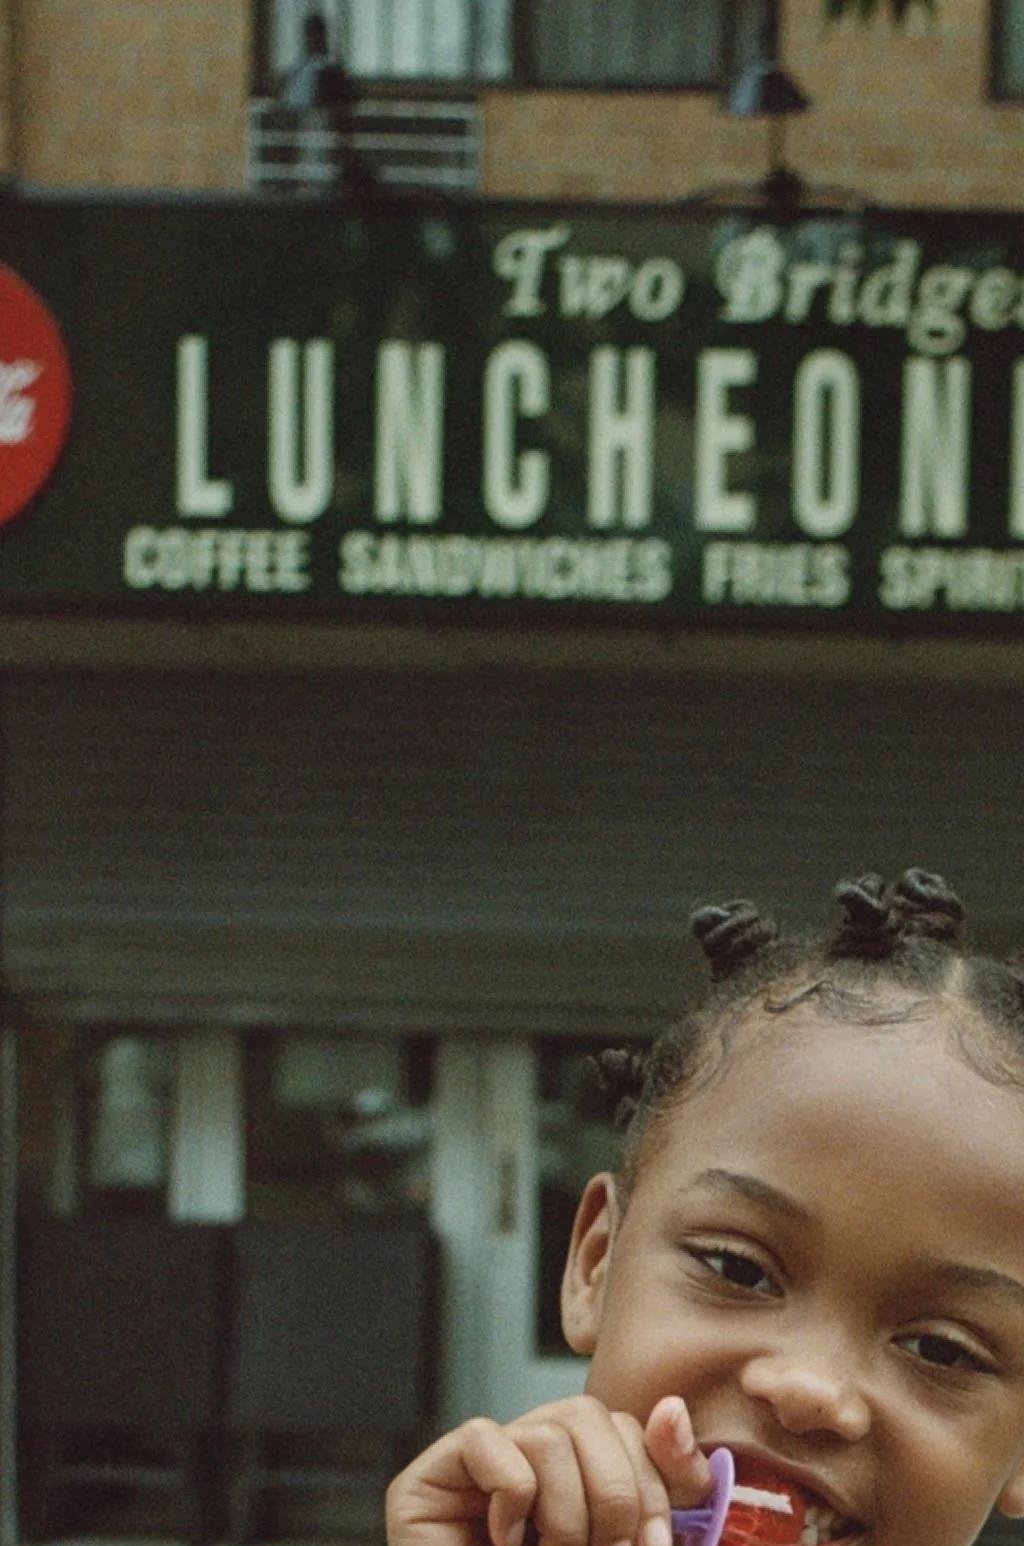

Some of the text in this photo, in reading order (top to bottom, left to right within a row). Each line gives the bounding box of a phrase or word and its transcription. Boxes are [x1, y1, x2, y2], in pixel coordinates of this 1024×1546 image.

[496, 224, 684, 321] Two
[122, 526, 312, 591] COFFEE
[339, 531, 673, 601] SANDWICHES
[702, 542, 851, 606] FRIES
